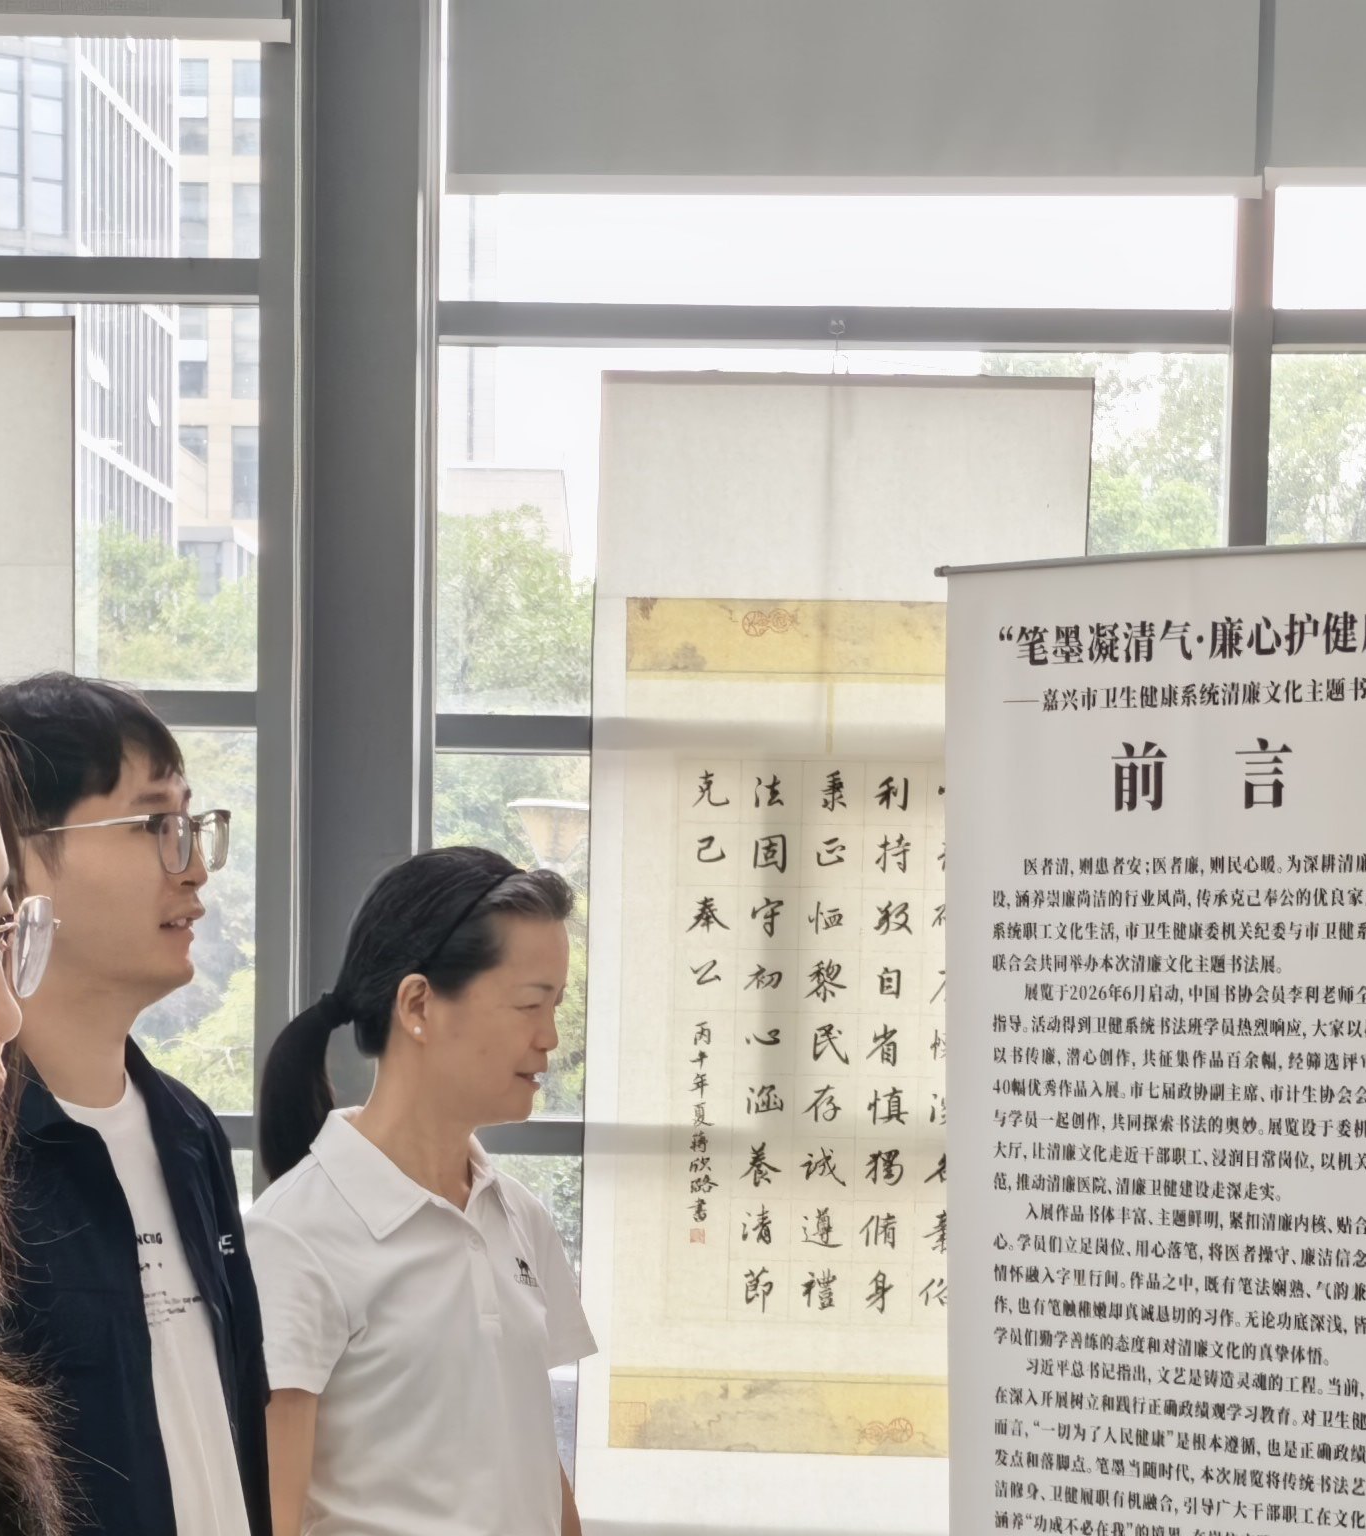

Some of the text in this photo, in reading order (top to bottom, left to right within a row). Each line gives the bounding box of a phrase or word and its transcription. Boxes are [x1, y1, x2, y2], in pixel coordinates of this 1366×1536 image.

[685, 769, 730, 987] 克己奉公
[993, 954, 1281, 973] 联合会共同举办本次清廉文化主题书法展。
